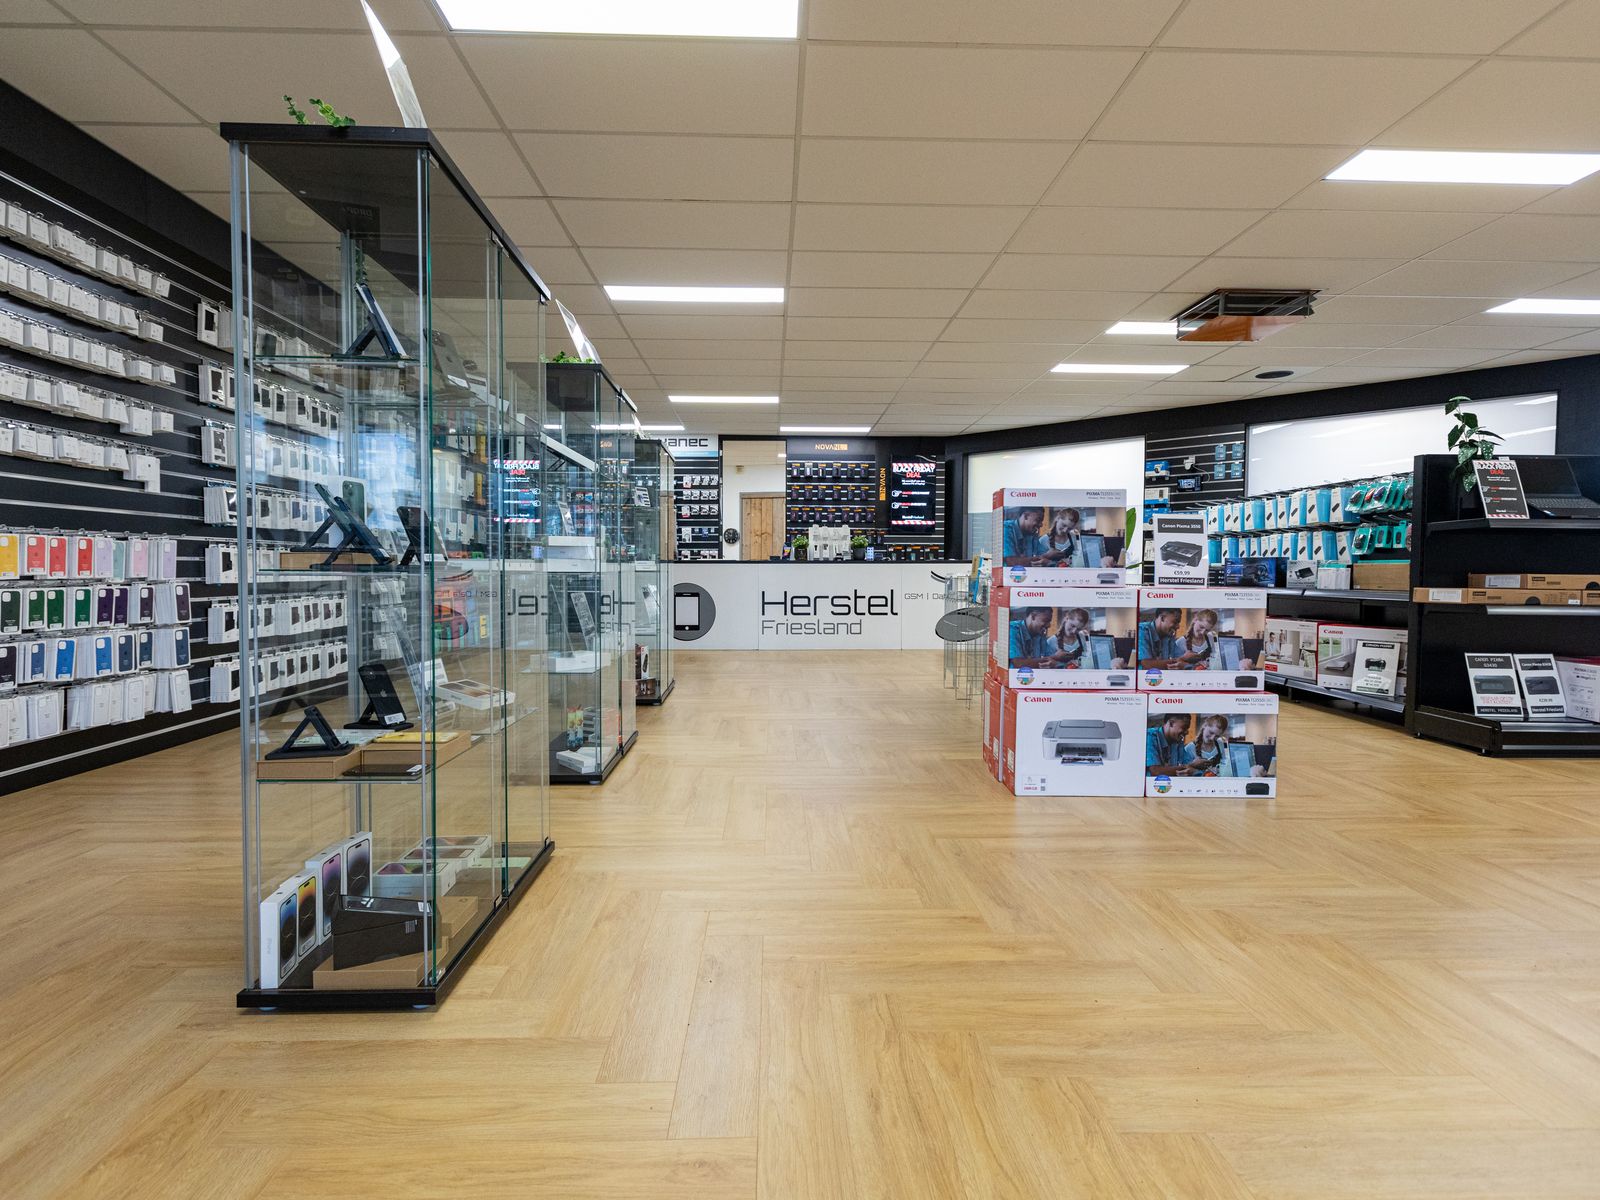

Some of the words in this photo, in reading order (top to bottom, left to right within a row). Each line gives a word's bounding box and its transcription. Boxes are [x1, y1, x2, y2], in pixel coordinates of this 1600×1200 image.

[761, 588, 899, 616] Herstel
[904, 592, 924, 600] GSM
[761, 618, 862, 635] Friesland
